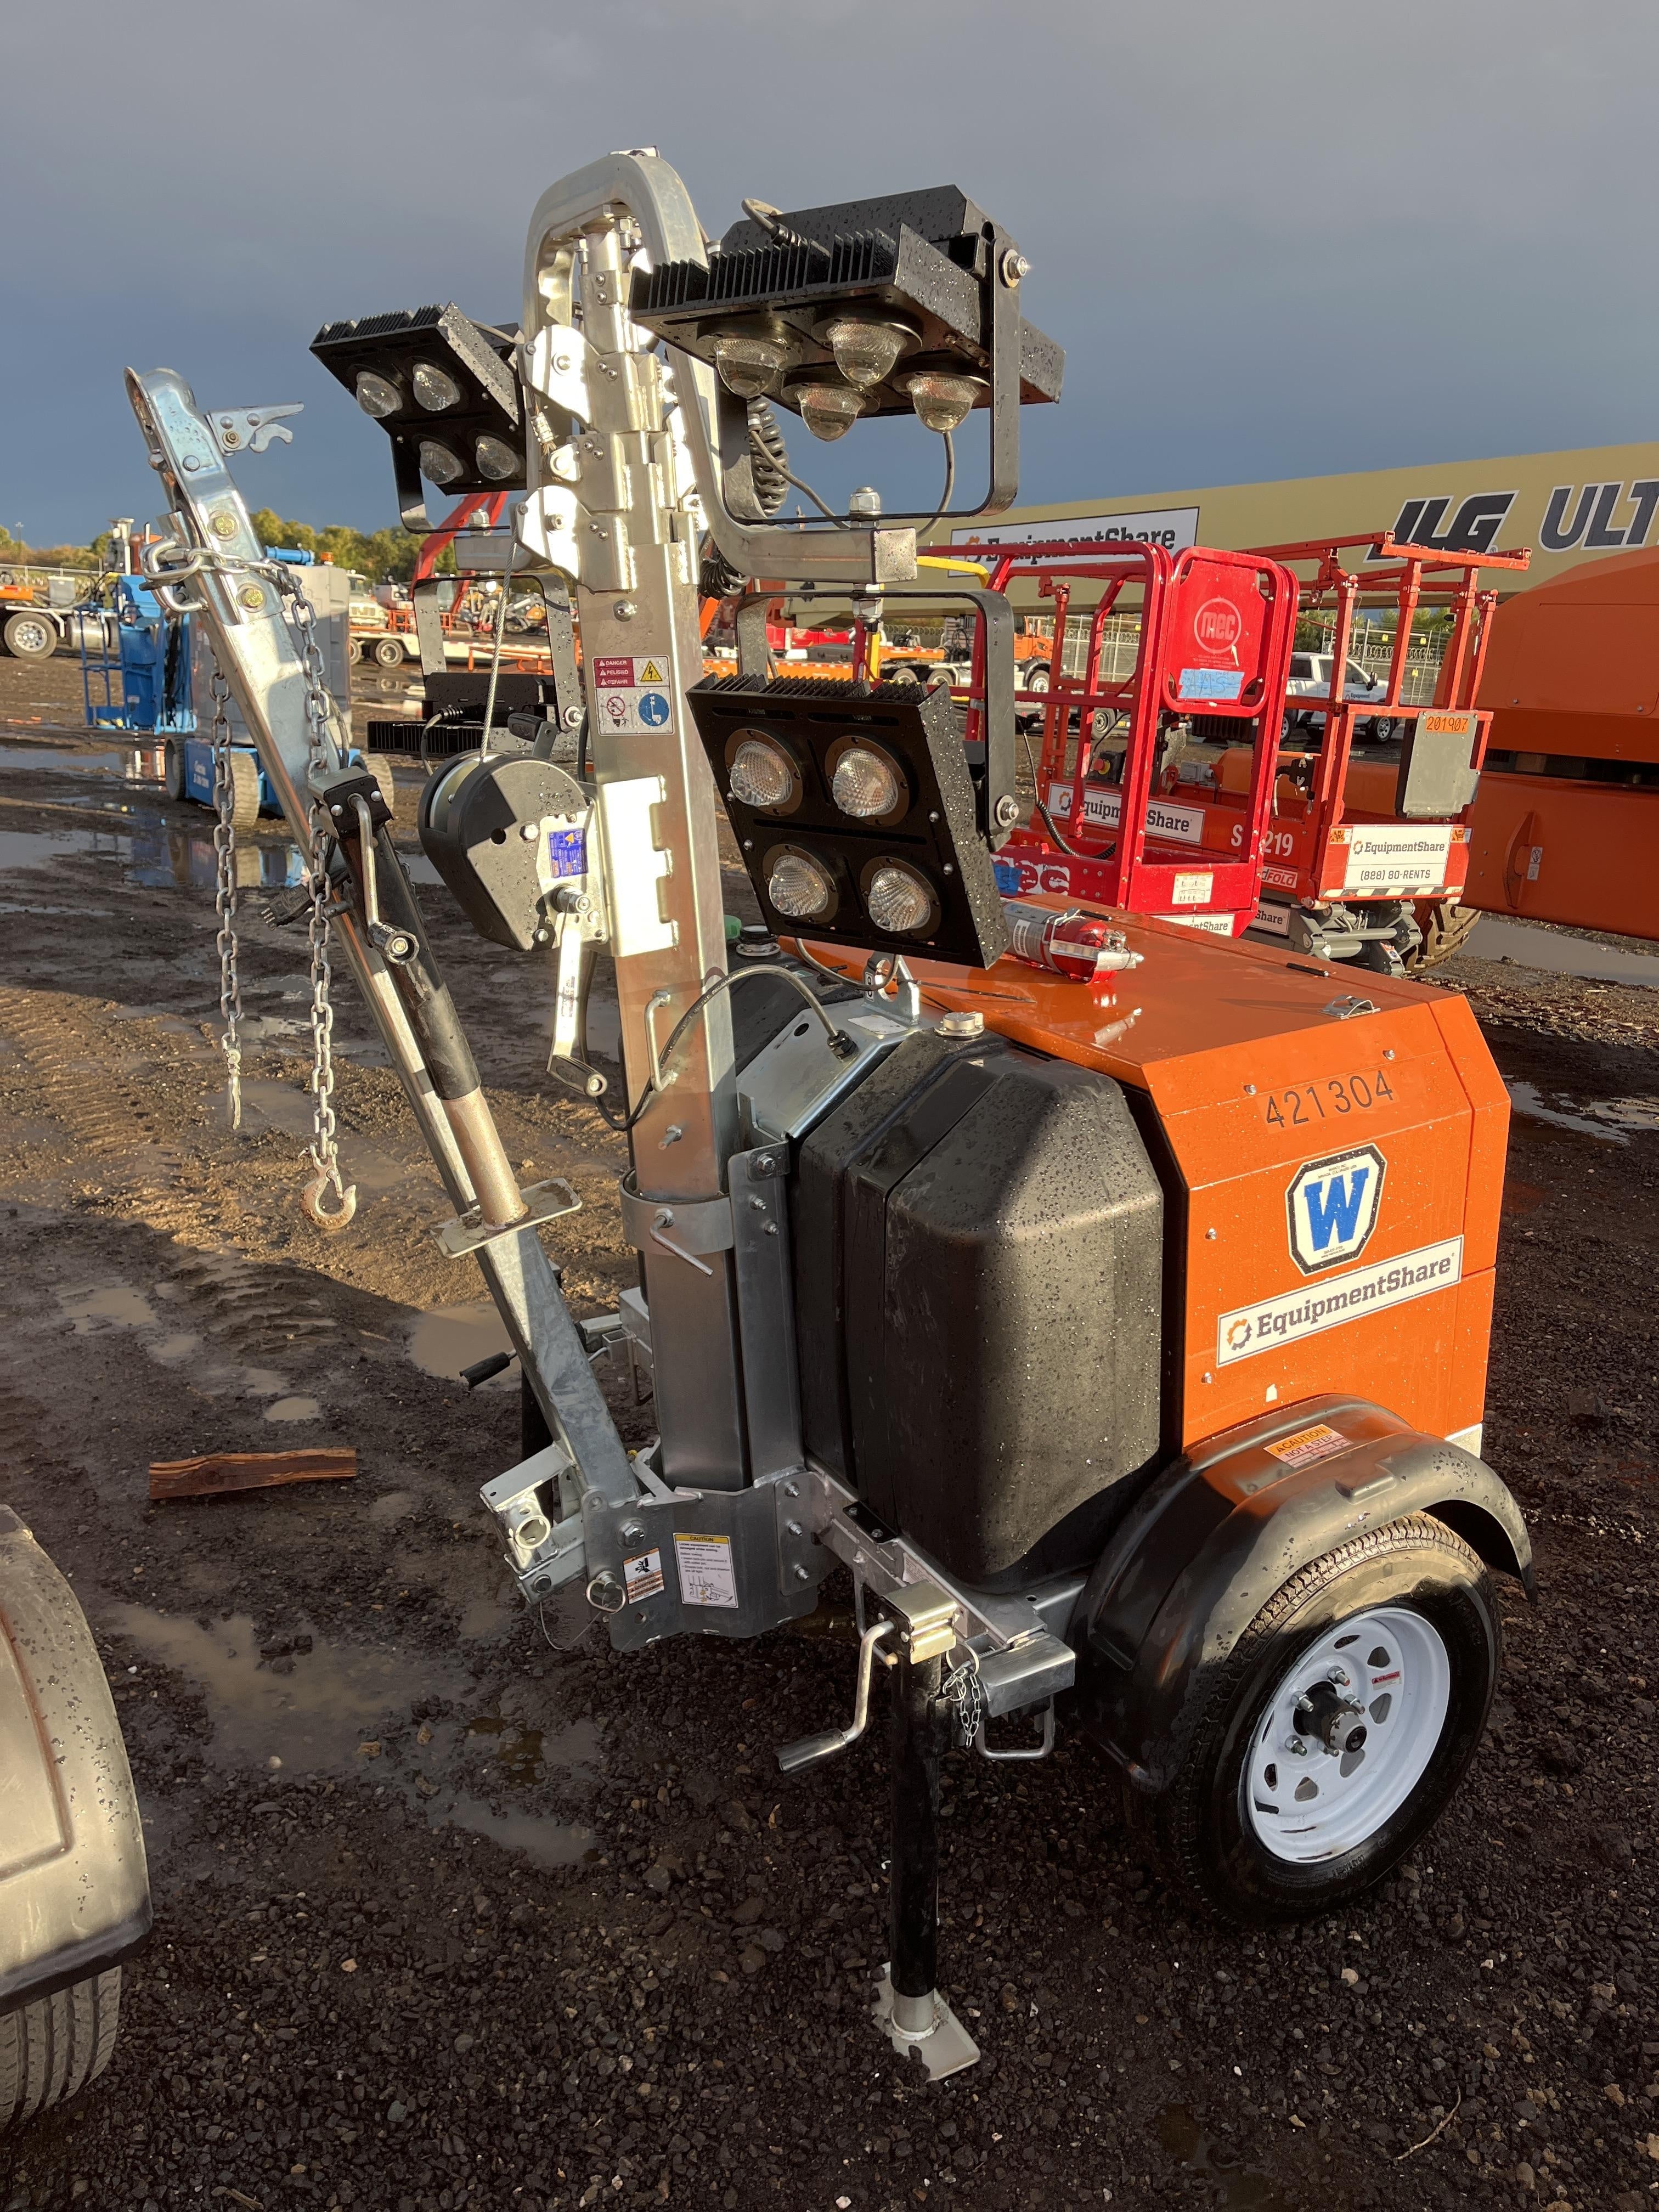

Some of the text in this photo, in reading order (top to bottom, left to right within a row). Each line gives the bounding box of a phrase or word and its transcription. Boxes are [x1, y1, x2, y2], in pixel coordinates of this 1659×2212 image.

[1363, 490, 1520, 563] JLG
[1426, 716, 1469, 731] 201907
[1364, 841, 1445, 855] EquipmentShare
[1361, 869, 1431, 881] (888) 80-RENTS
[1266, 1070, 1393, 1128] 421304
[1304, 1166, 1370, 1252] W
[1256, 1256, 1452, 1339] EquipmentShare
[1279, 1428, 1327, 1448] CAUTION
[1285, 1448, 1305, 1458] NOT
[1311, 1435, 1333, 1446] STEP
